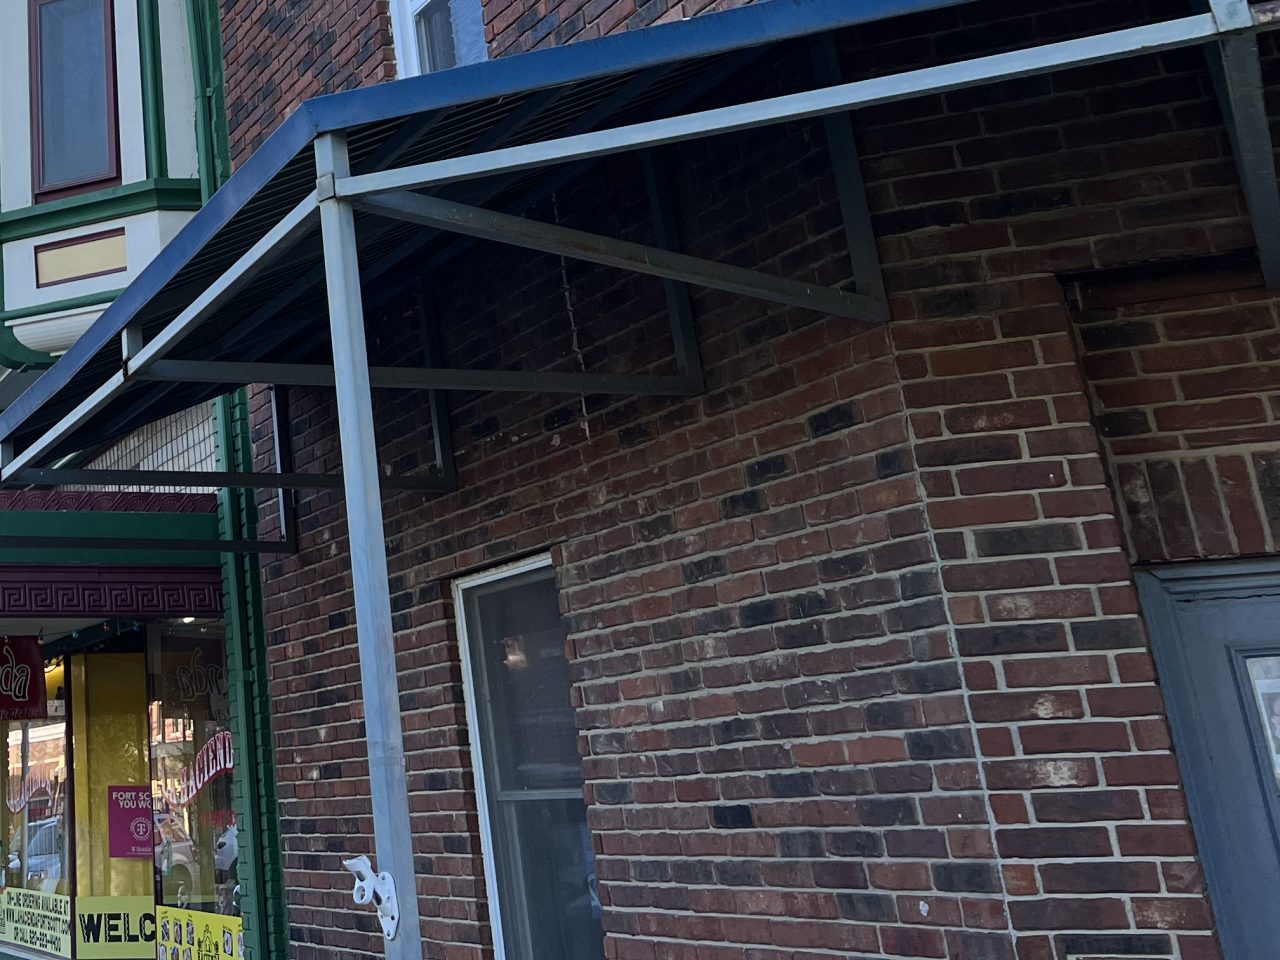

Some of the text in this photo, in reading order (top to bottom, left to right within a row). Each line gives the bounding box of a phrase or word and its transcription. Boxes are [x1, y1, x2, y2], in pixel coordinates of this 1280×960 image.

[112, 792, 136, 800] FORT
[118, 800, 137, 809] YOU
[79, 912, 156, 943] WELC
